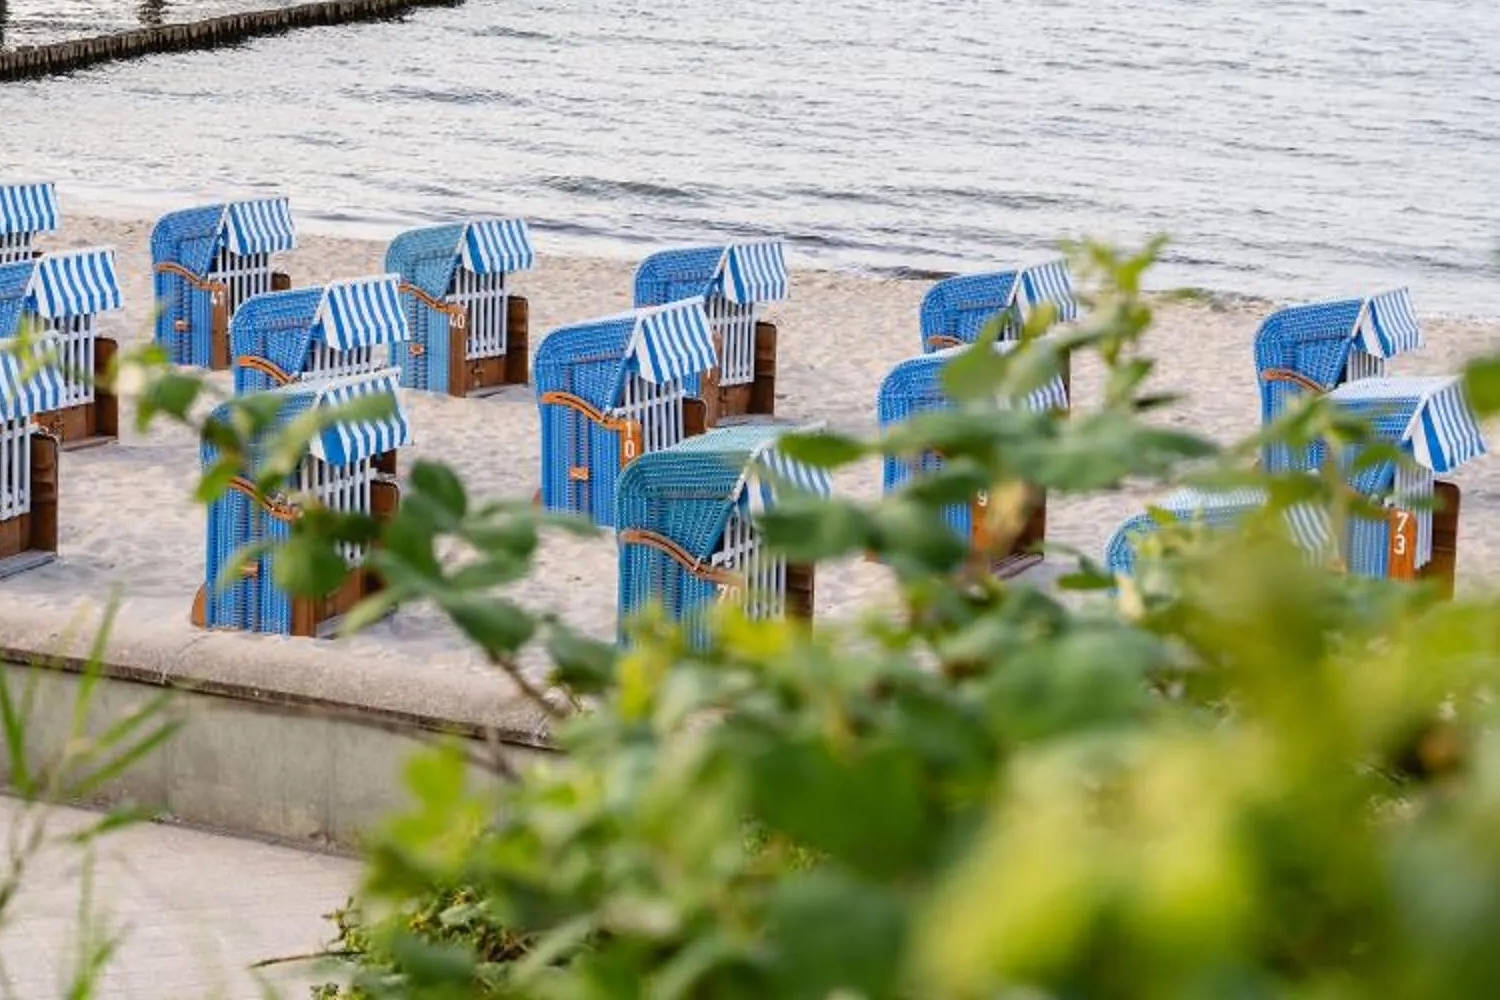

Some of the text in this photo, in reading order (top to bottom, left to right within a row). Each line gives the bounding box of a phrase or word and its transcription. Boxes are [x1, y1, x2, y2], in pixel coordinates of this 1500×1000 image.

[449, 312, 465, 329] 40
[625, 420, 635, 459] 10
[1394, 511, 1409, 555] 73
